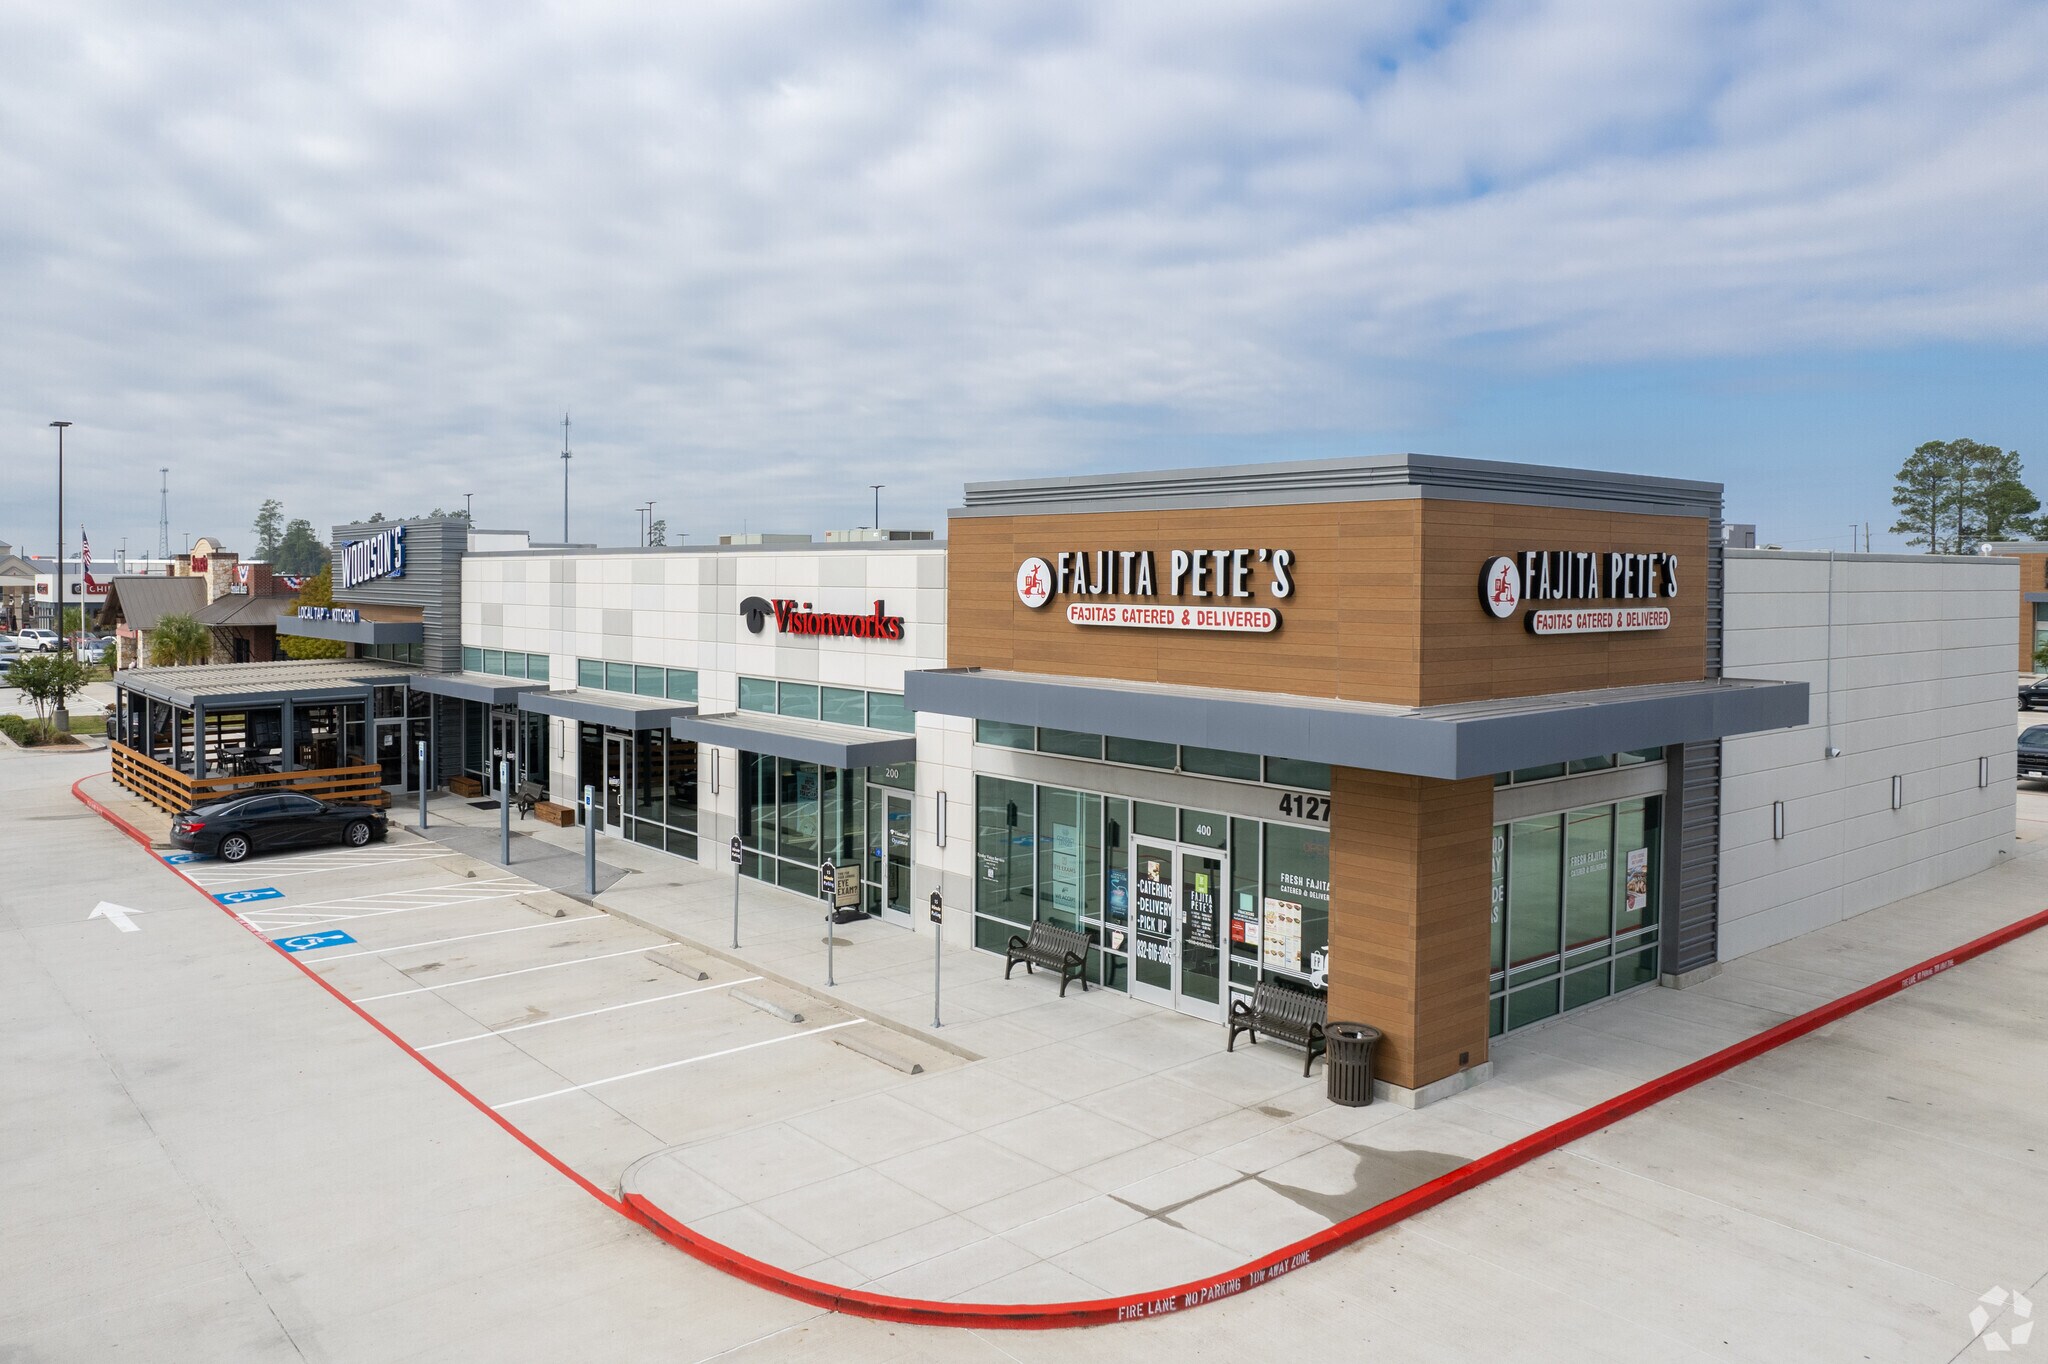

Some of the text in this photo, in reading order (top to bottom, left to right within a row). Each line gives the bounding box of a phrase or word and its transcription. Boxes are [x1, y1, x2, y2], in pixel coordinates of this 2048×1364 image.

[341, 525, 403, 588] WOODSON'S
[1057, 549, 1292, 598] FAJITA PETE'S
[1525, 551, 1678, 599] FAJITA PETE'S
[297, 605, 313, 619] LOCAL
[314, 607, 325, 620] TAP
[332, 608, 356, 623] KITCHEN
[771, 598, 901, 640] Visionworks
[1071, 606, 1271, 628] FAJITAS CATERED & DELIVERED
[1536, 611, 1668, 630] FAJITAS CATERED & DELIVERED
[885, 768, 899, 779] 200
[1279, 793, 1330, 821] 4127
[1196, 824, 1212, 836] 400
[837, 879, 849, 887] EYE
[1280, 873, 1304, 886] FRESH
[837, 886, 858, 896] EXAM?
[1191, 890, 1213, 903] FAJITA
[1280, 885, 1302, 896] CATERED
[1191, 901, 1213, 914] PETE'S
[1157, 919, 1167, 933] UP
[1118, 1249, 1310, 1321] FIRE LANE NO PARKING TOW AWAY ZONE
